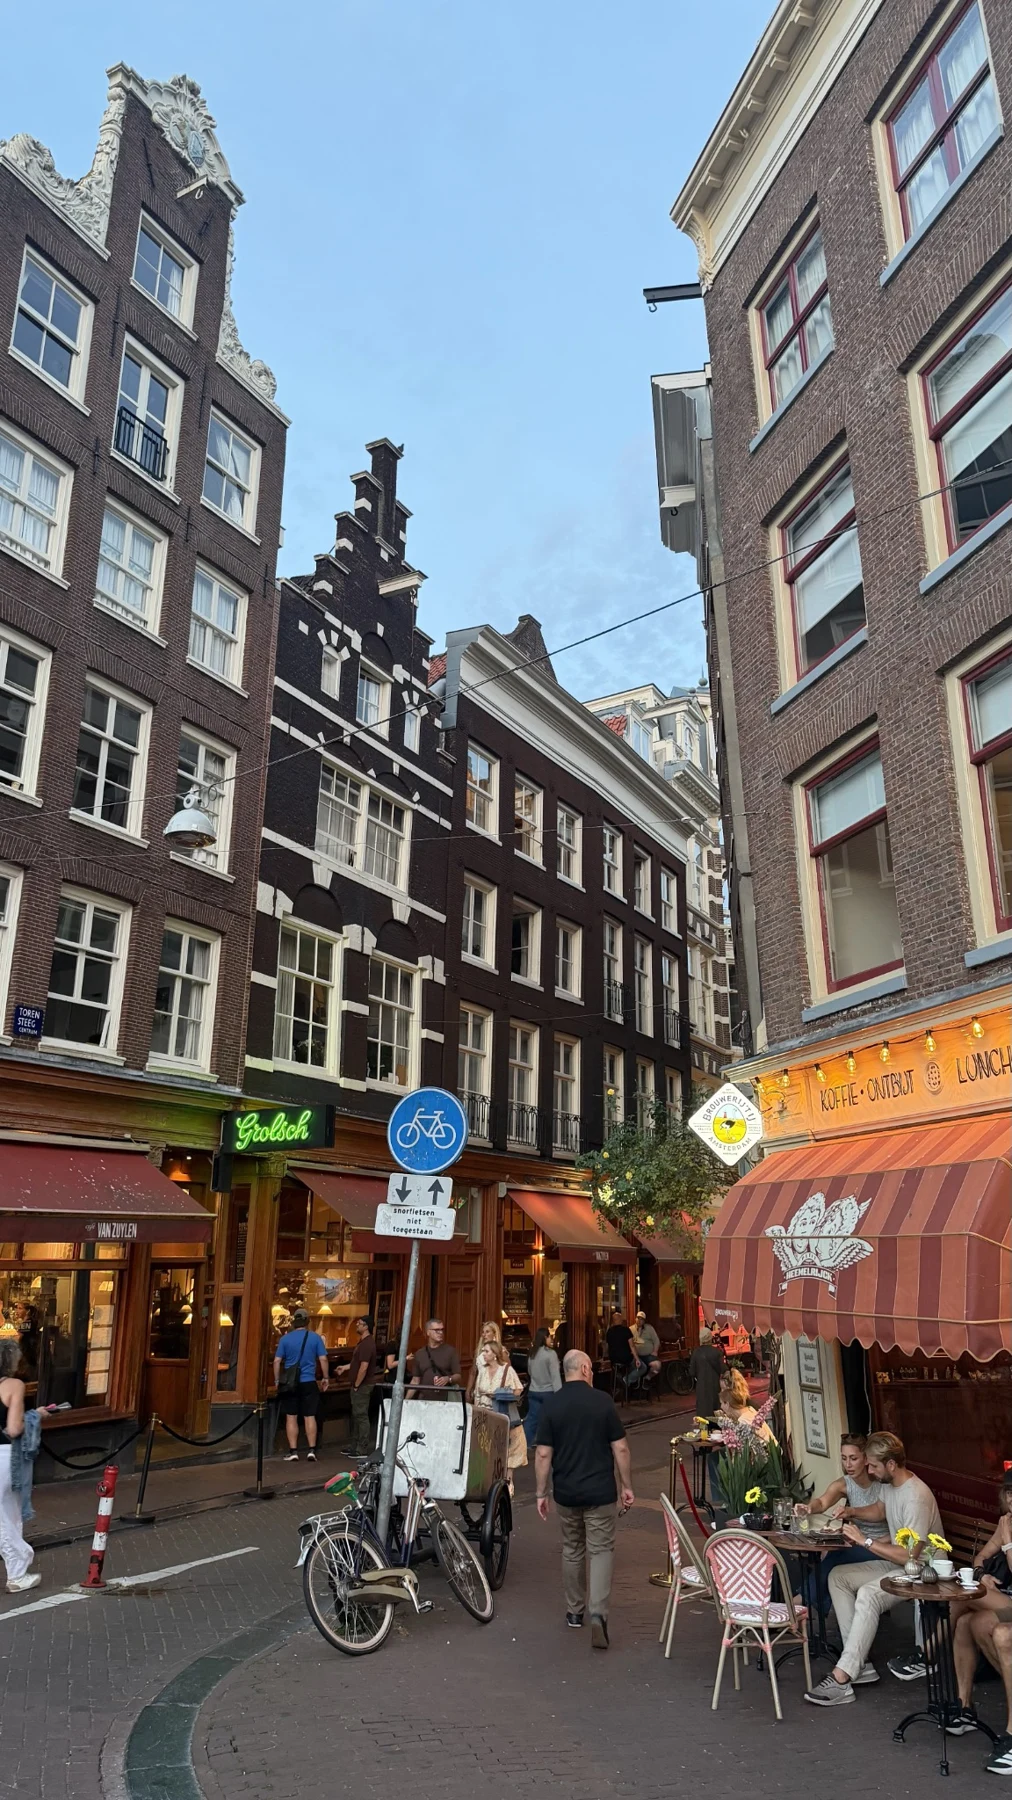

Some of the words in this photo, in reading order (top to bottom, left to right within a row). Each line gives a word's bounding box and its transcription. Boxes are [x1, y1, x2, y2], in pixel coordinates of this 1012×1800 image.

[19, 1007, 41, 1020] TOREN
[17, 1017, 36, 1028] STEEG
[18, 1027, 38, 1035] CENTRUM
[956, 1045, 1012, 1084] LUNCH
[820, 1082, 859, 1112] KOFFIE
[867, 1069, 914, 1102] ONTBIJT
[235, 1110, 312, 1150] Grolsch
[708, 1136, 753, 1151] AMSTERDAM
[393, 1207, 435, 1216] snorfietsen
[97, 1222, 111, 1238] VAN
[111, 1222, 138, 1239] ZUYLEN
[393, 1226, 433, 1235] toegestaan
